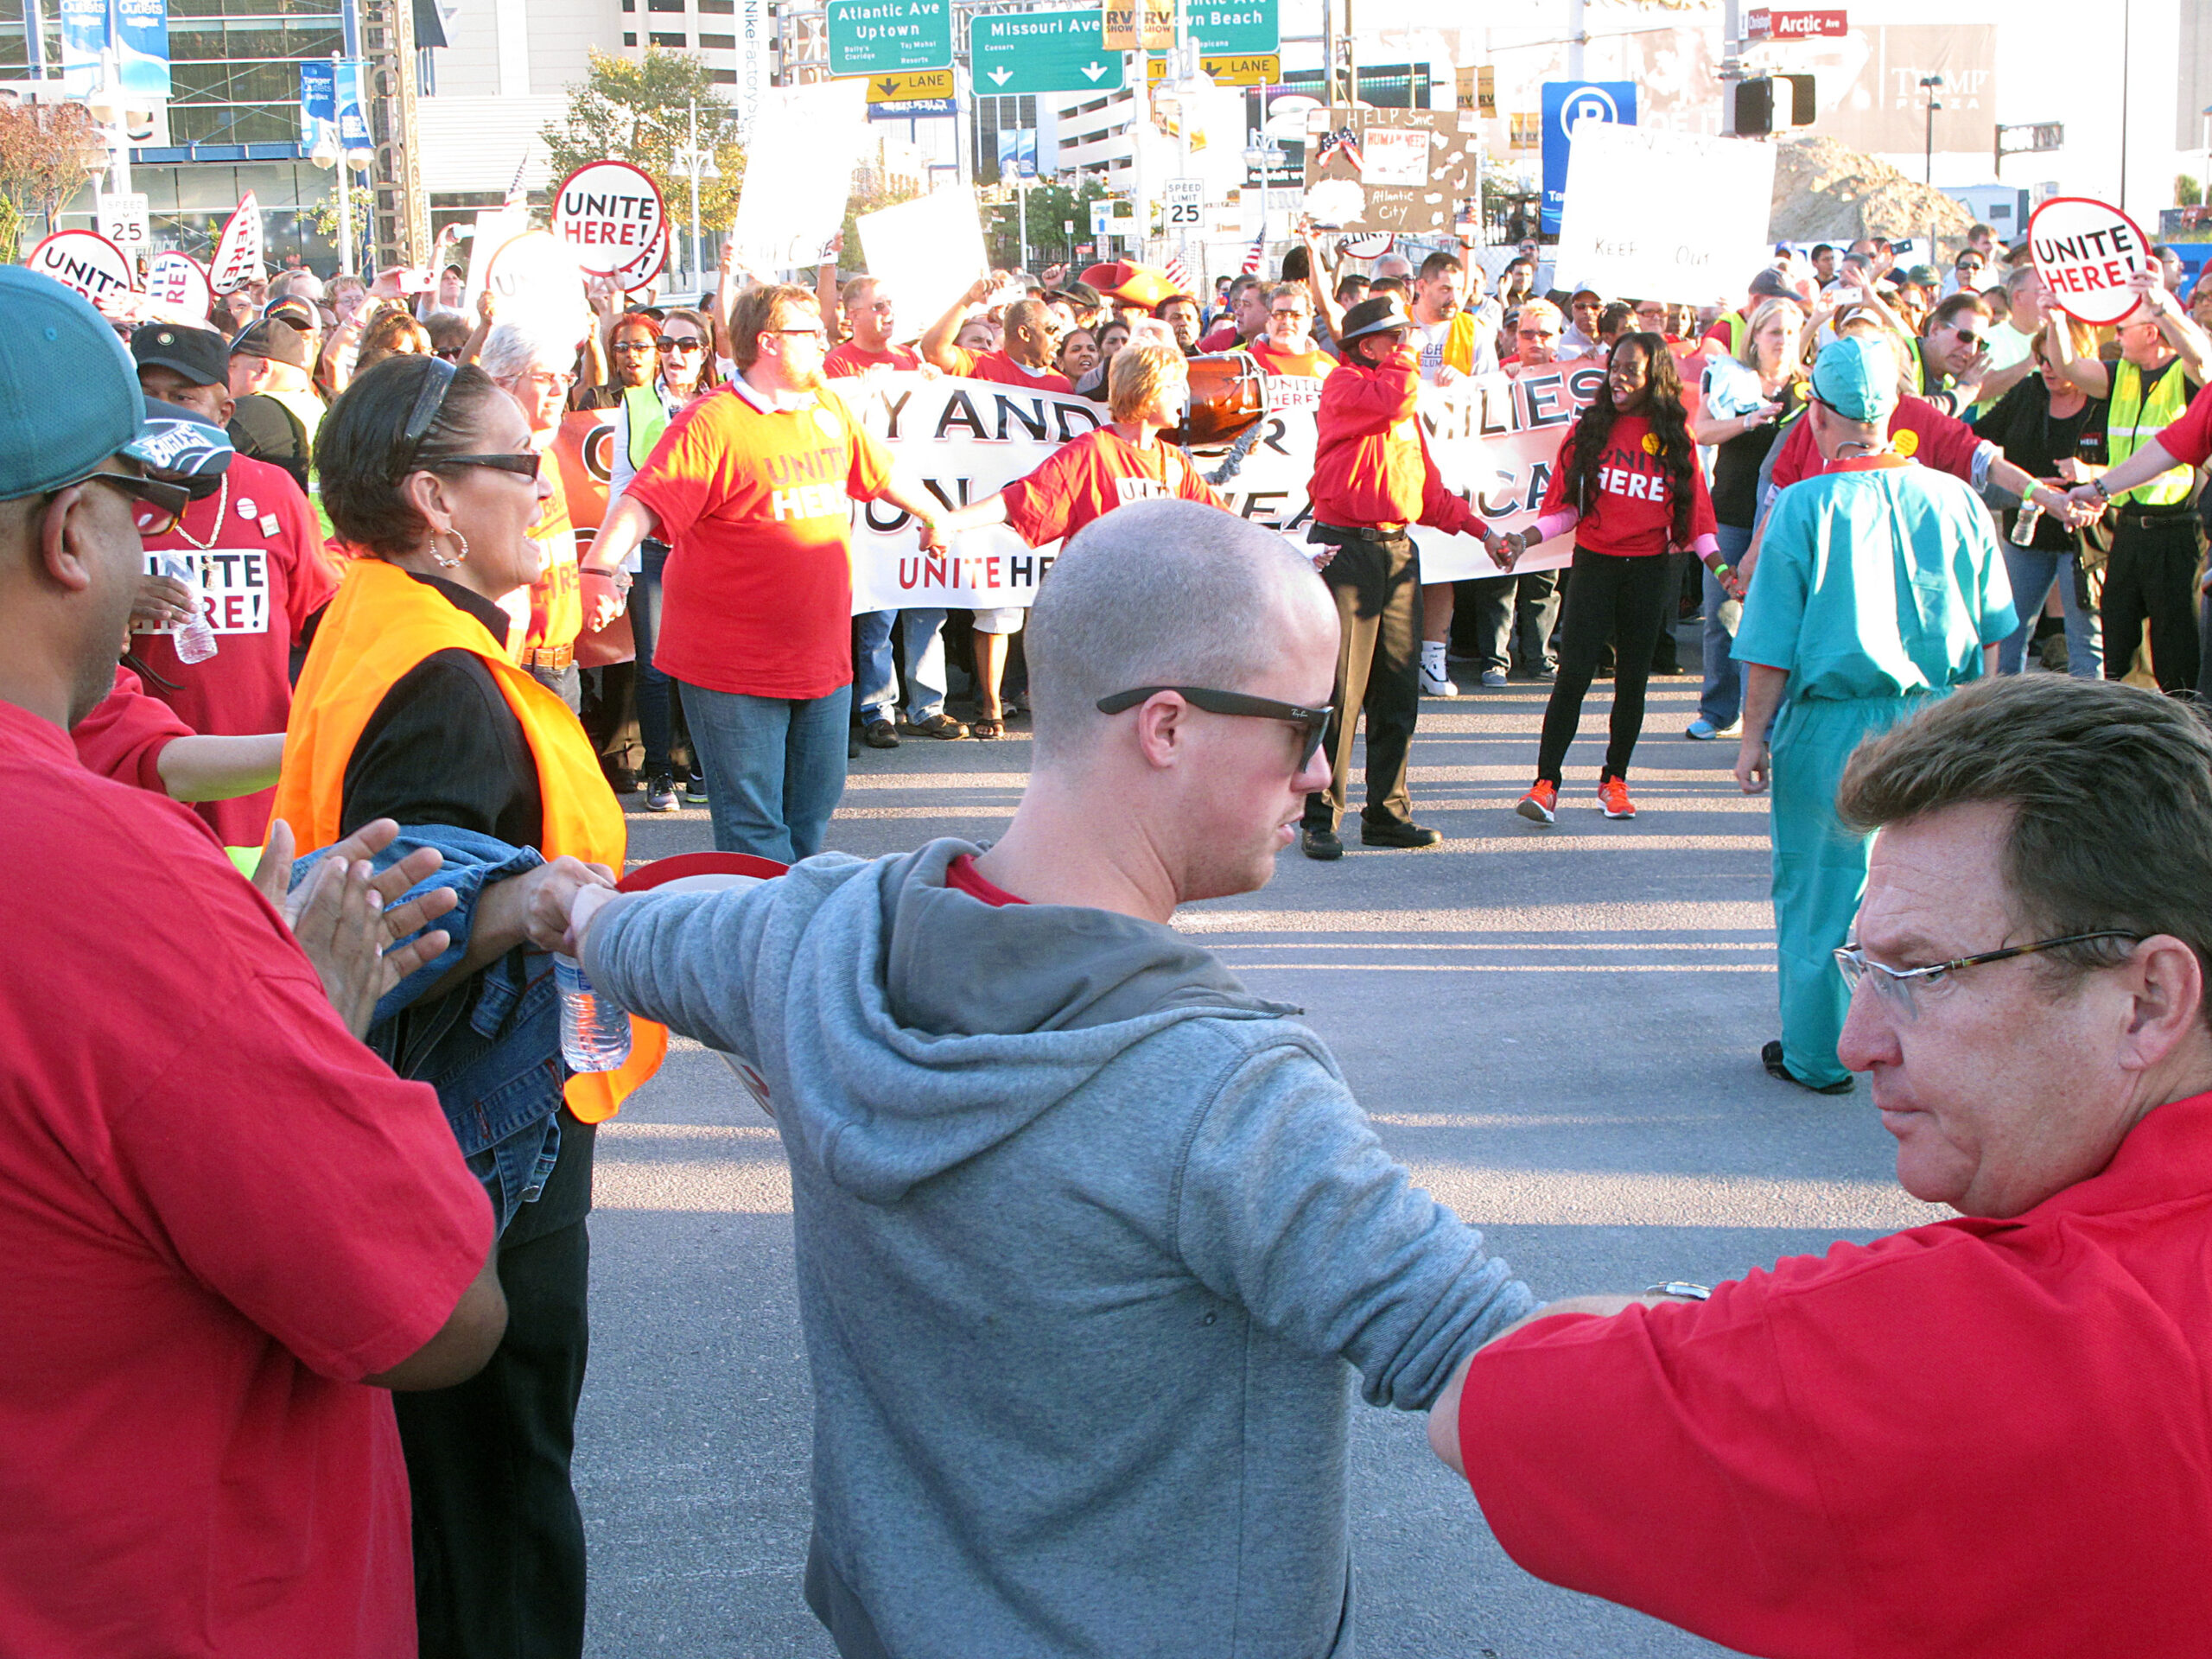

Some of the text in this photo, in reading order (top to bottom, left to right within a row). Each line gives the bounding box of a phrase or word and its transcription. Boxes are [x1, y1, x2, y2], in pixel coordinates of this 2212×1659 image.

[838, 2, 940, 21] Atlantic Ave
[1106, 10, 1134, 25] RV
[1144, 11, 1171, 24] RV
[1211, 10, 1262, 26] Beach
[991, 19, 1100, 36] Missouri Ave
[1106, 25, 1134, 34] SHOW
[1144, 25, 1171, 34] SHOW
[1779, 14, 1840, 32] Arctic Ave
[856, 24, 919, 41] Uptown
[1231, 60, 1270, 73] LANE
[909, 74, 944, 87] LANE
[1891, 67, 1991, 97] TRMP
[1478, 93, 1495, 104] RV
[1896, 98, 1980, 110] PLZA
[1346, 109, 1400, 129] HELP
[1168, 183, 1202, 193] SPEED
[1371, 189, 1414, 205] Atlantic
[564, 192, 655, 221] UNITE
[1172, 194, 1198, 202] LIMIT
[1171, 204, 1199, 223] 25
[1379, 205, 1408, 226] City
[112, 223, 143, 241] 25
[564, 219, 649, 247] HERE!
[2034, 223, 2133, 265] UNITE
[150, 260, 168, 297] ITE
[165, 262, 189, 304] RE!
[2044, 255, 2136, 295] HERE!
[934, 389, 1103, 444] AND
[141, 422, 215, 469] EAGLES
[1597, 467, 1664, 502] HERE
[899, 556, 1001, 589] UNITE
